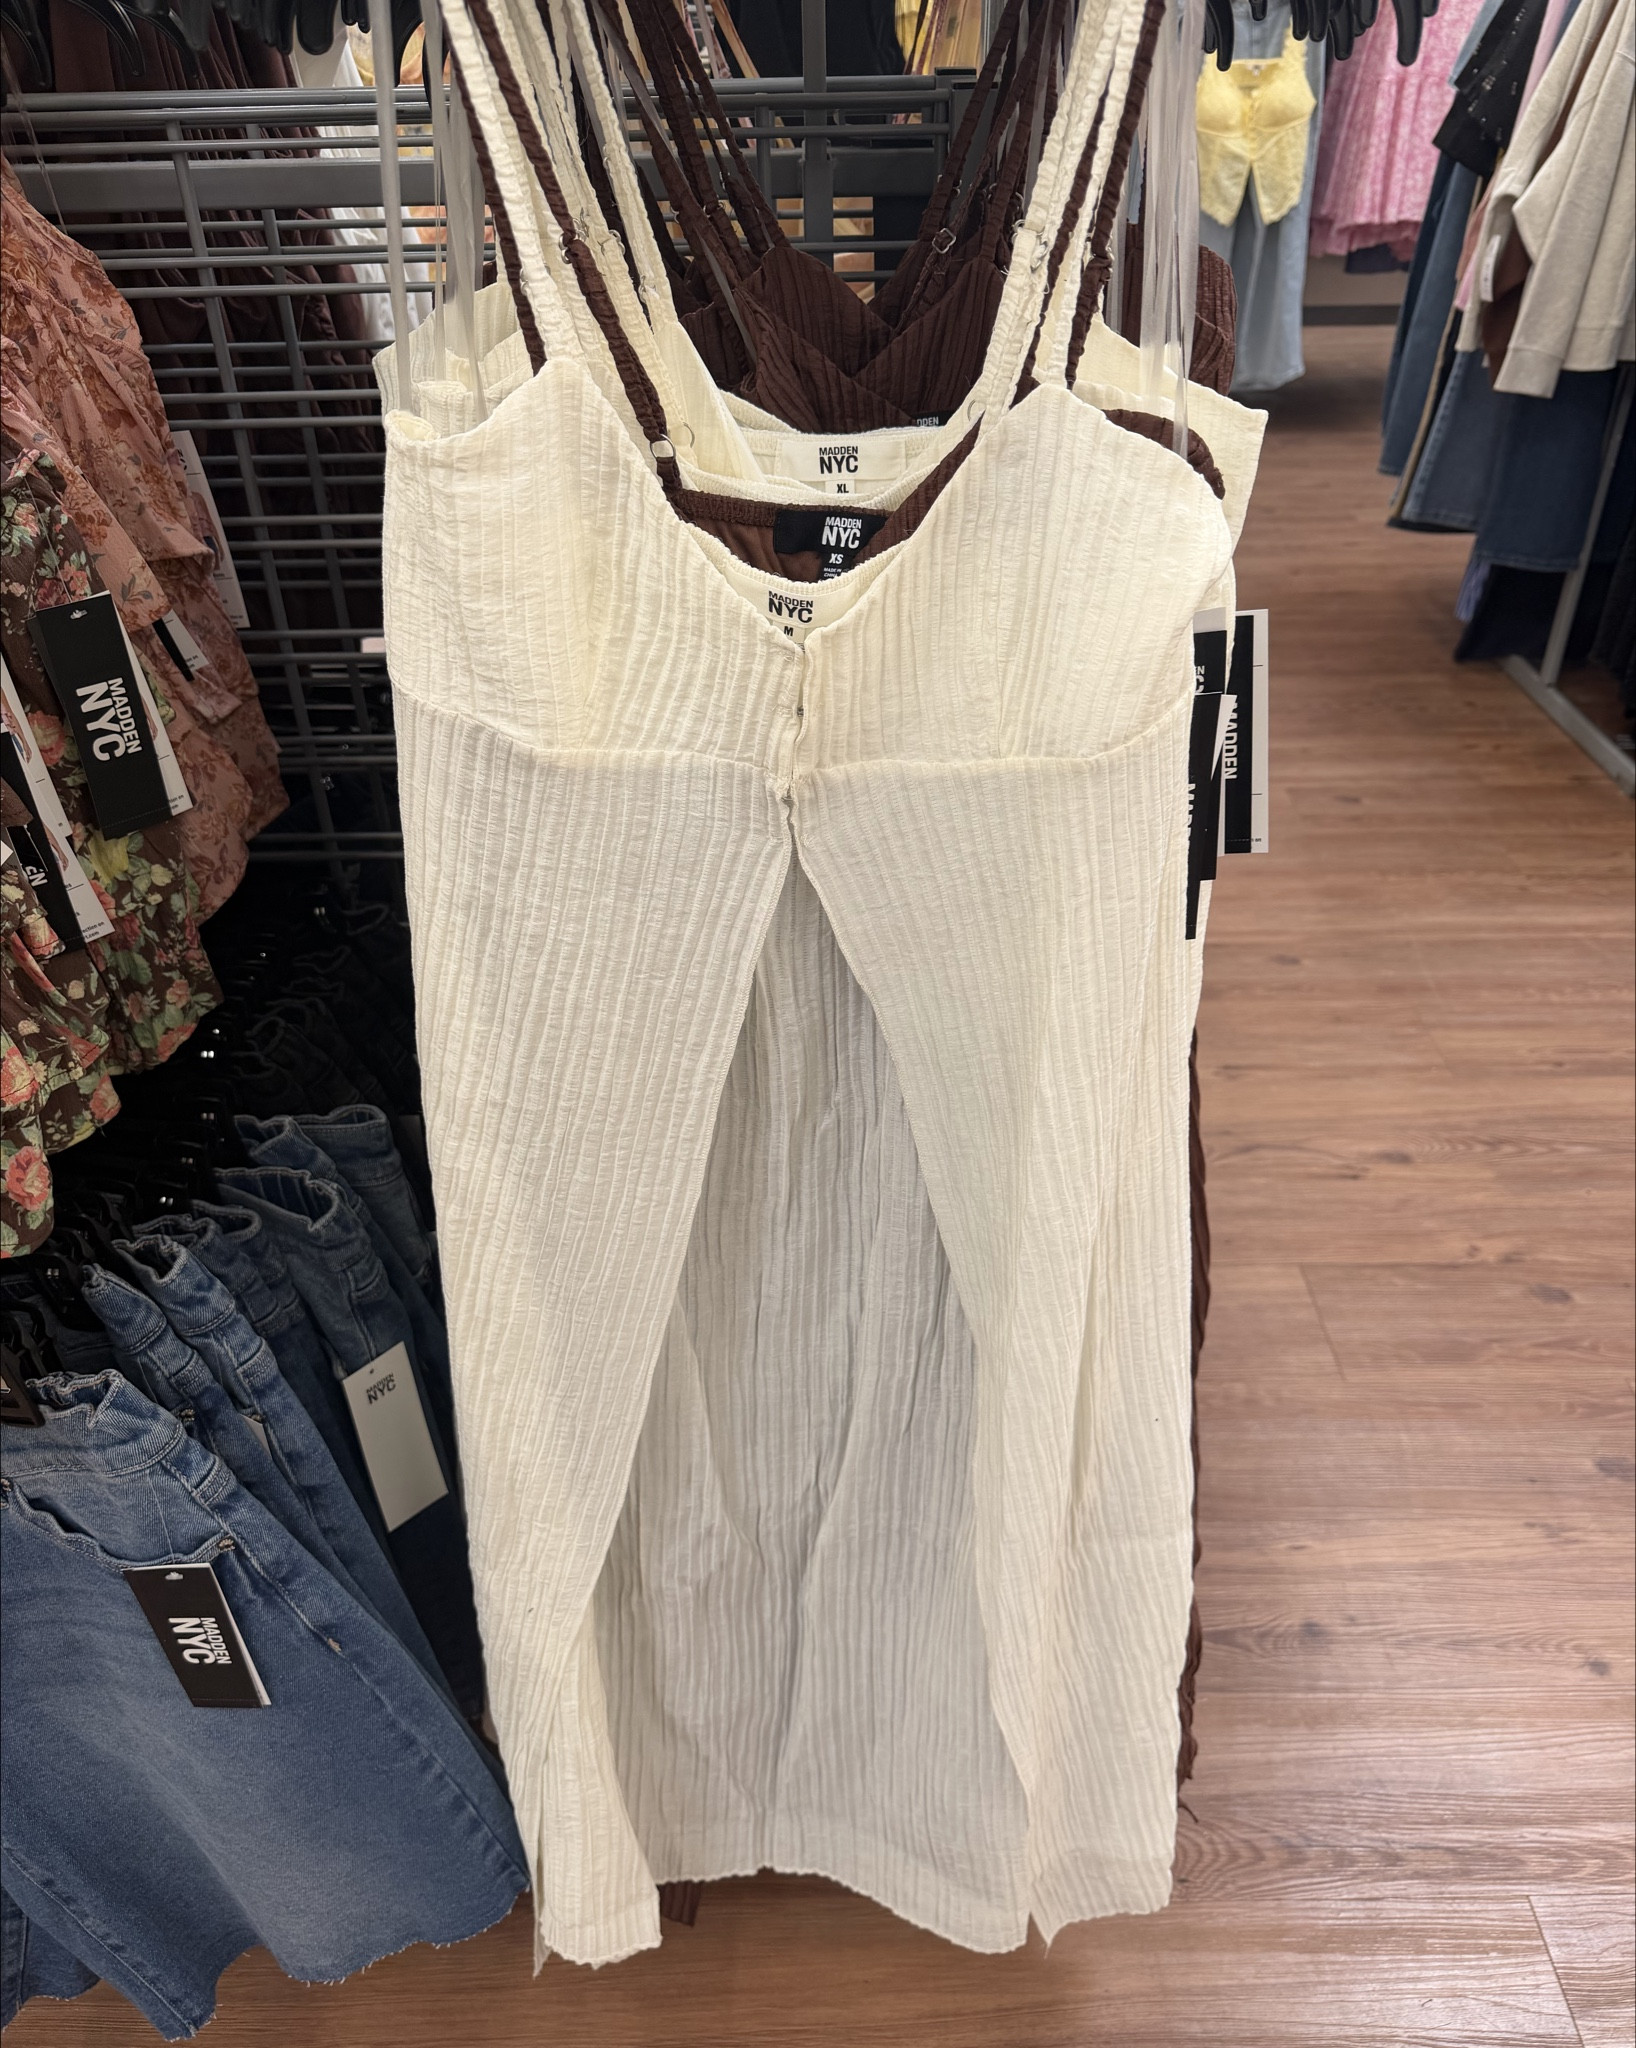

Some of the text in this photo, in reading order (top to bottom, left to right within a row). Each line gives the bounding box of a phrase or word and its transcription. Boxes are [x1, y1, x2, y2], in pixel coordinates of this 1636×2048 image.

[916, 416, 939, 427] DDEN
[819, 446, 858, 456] MADDEN
[820, 455, 858, 475] NYC
[836, 483, 849, 493] XL
[825, 516, 862, 529] MADDEN
[821, 526, 861, 549] NYC
[829, 553, 844, 564] XS
[768, 590, 814, 608] MADDEN
[768, 597, 813, 624] NYC
[784, 625, 794, 637] M
[75, 681, 126, 762] NYC
[107, 677, 143, 754] MADDEN
[367, 1378, 396, 1405] NYC
[168, 1617, 216, 1664] NYC
[200, 1617, 233, 1664] MADDEN
